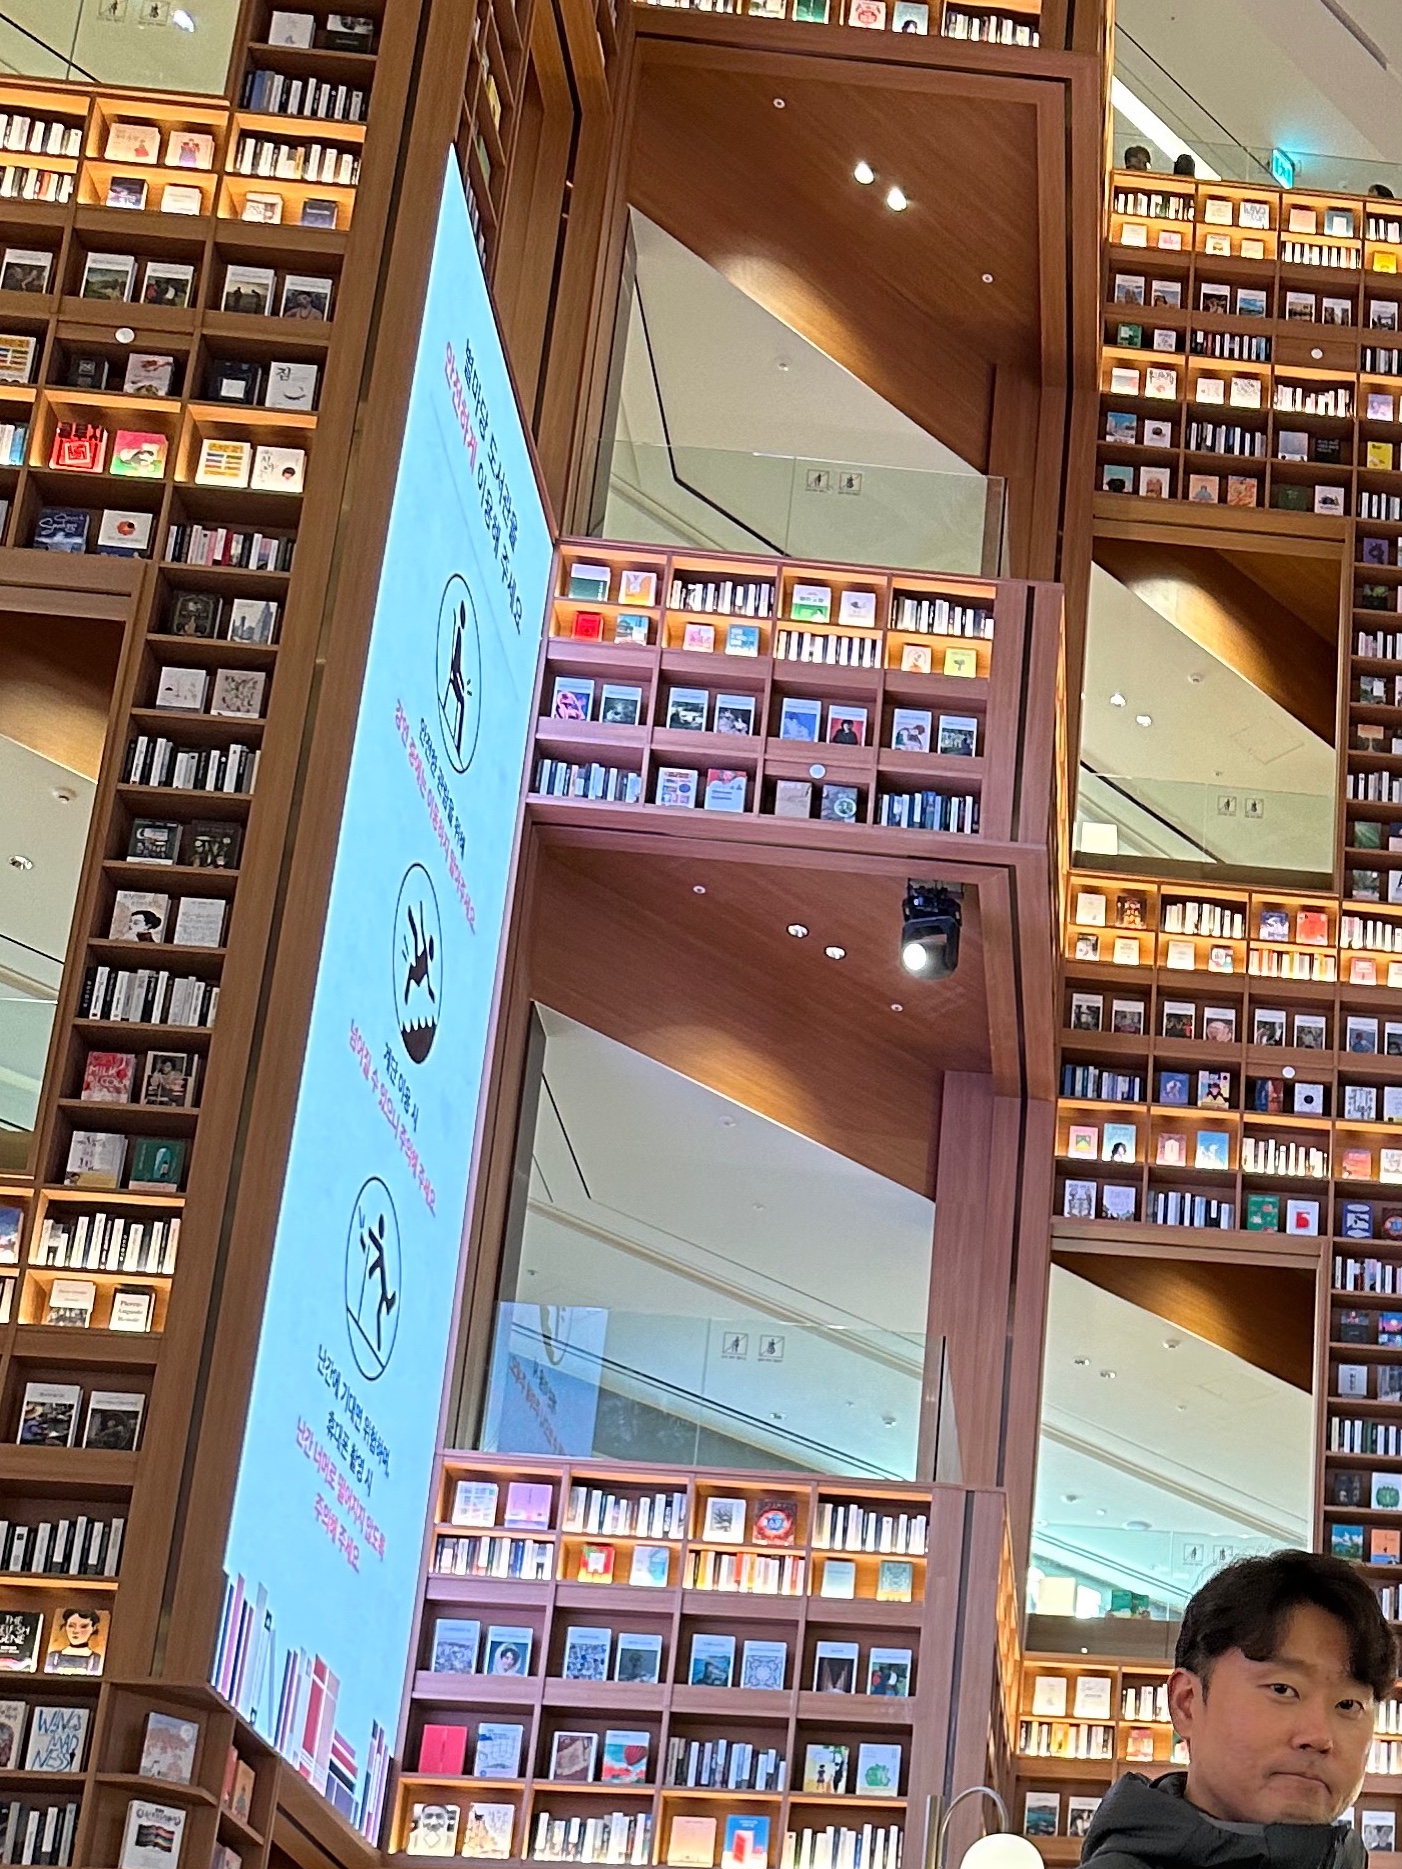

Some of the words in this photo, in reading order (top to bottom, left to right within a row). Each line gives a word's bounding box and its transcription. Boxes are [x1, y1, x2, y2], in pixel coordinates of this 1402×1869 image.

[445, 341, 478, 475] 안전하게
[477, 462, 501, 559] 이용해
[500, 544, 522, 635] 주세요
[464, 338, 489, 441] 별마당
[487, 432, 518, 553] 도서관을
[349, 1019, 372, 1081] 넘어질
[371, 1068, 379, 1093] 수
[378, 1083, 400, 1139] 있으니
[399, 1123, 418, 1180] 주의해
[417, 1163, 436, 1218] 주세요
[383, 1042, 398, 1086] 계단
[398, 1073, 411, 1114] 이용
[411, 1103, 419, 1133] 시
[317, 1343, 342, 1401] 난간에
[341, 1382, 364, 1433] 기대면
[296, 1414, 314, 1459] 난간
[313, 1440, 337, 1491] 너머로
[326, 1410, 349, 1462] 휴대폰
[349, 1443, 365, 1483] 촬영
[364, 1468, 374, 1497] 시
[314, 1492, 339, 1545] 주의해
[338, 1523, 360, 1574] 주세요
